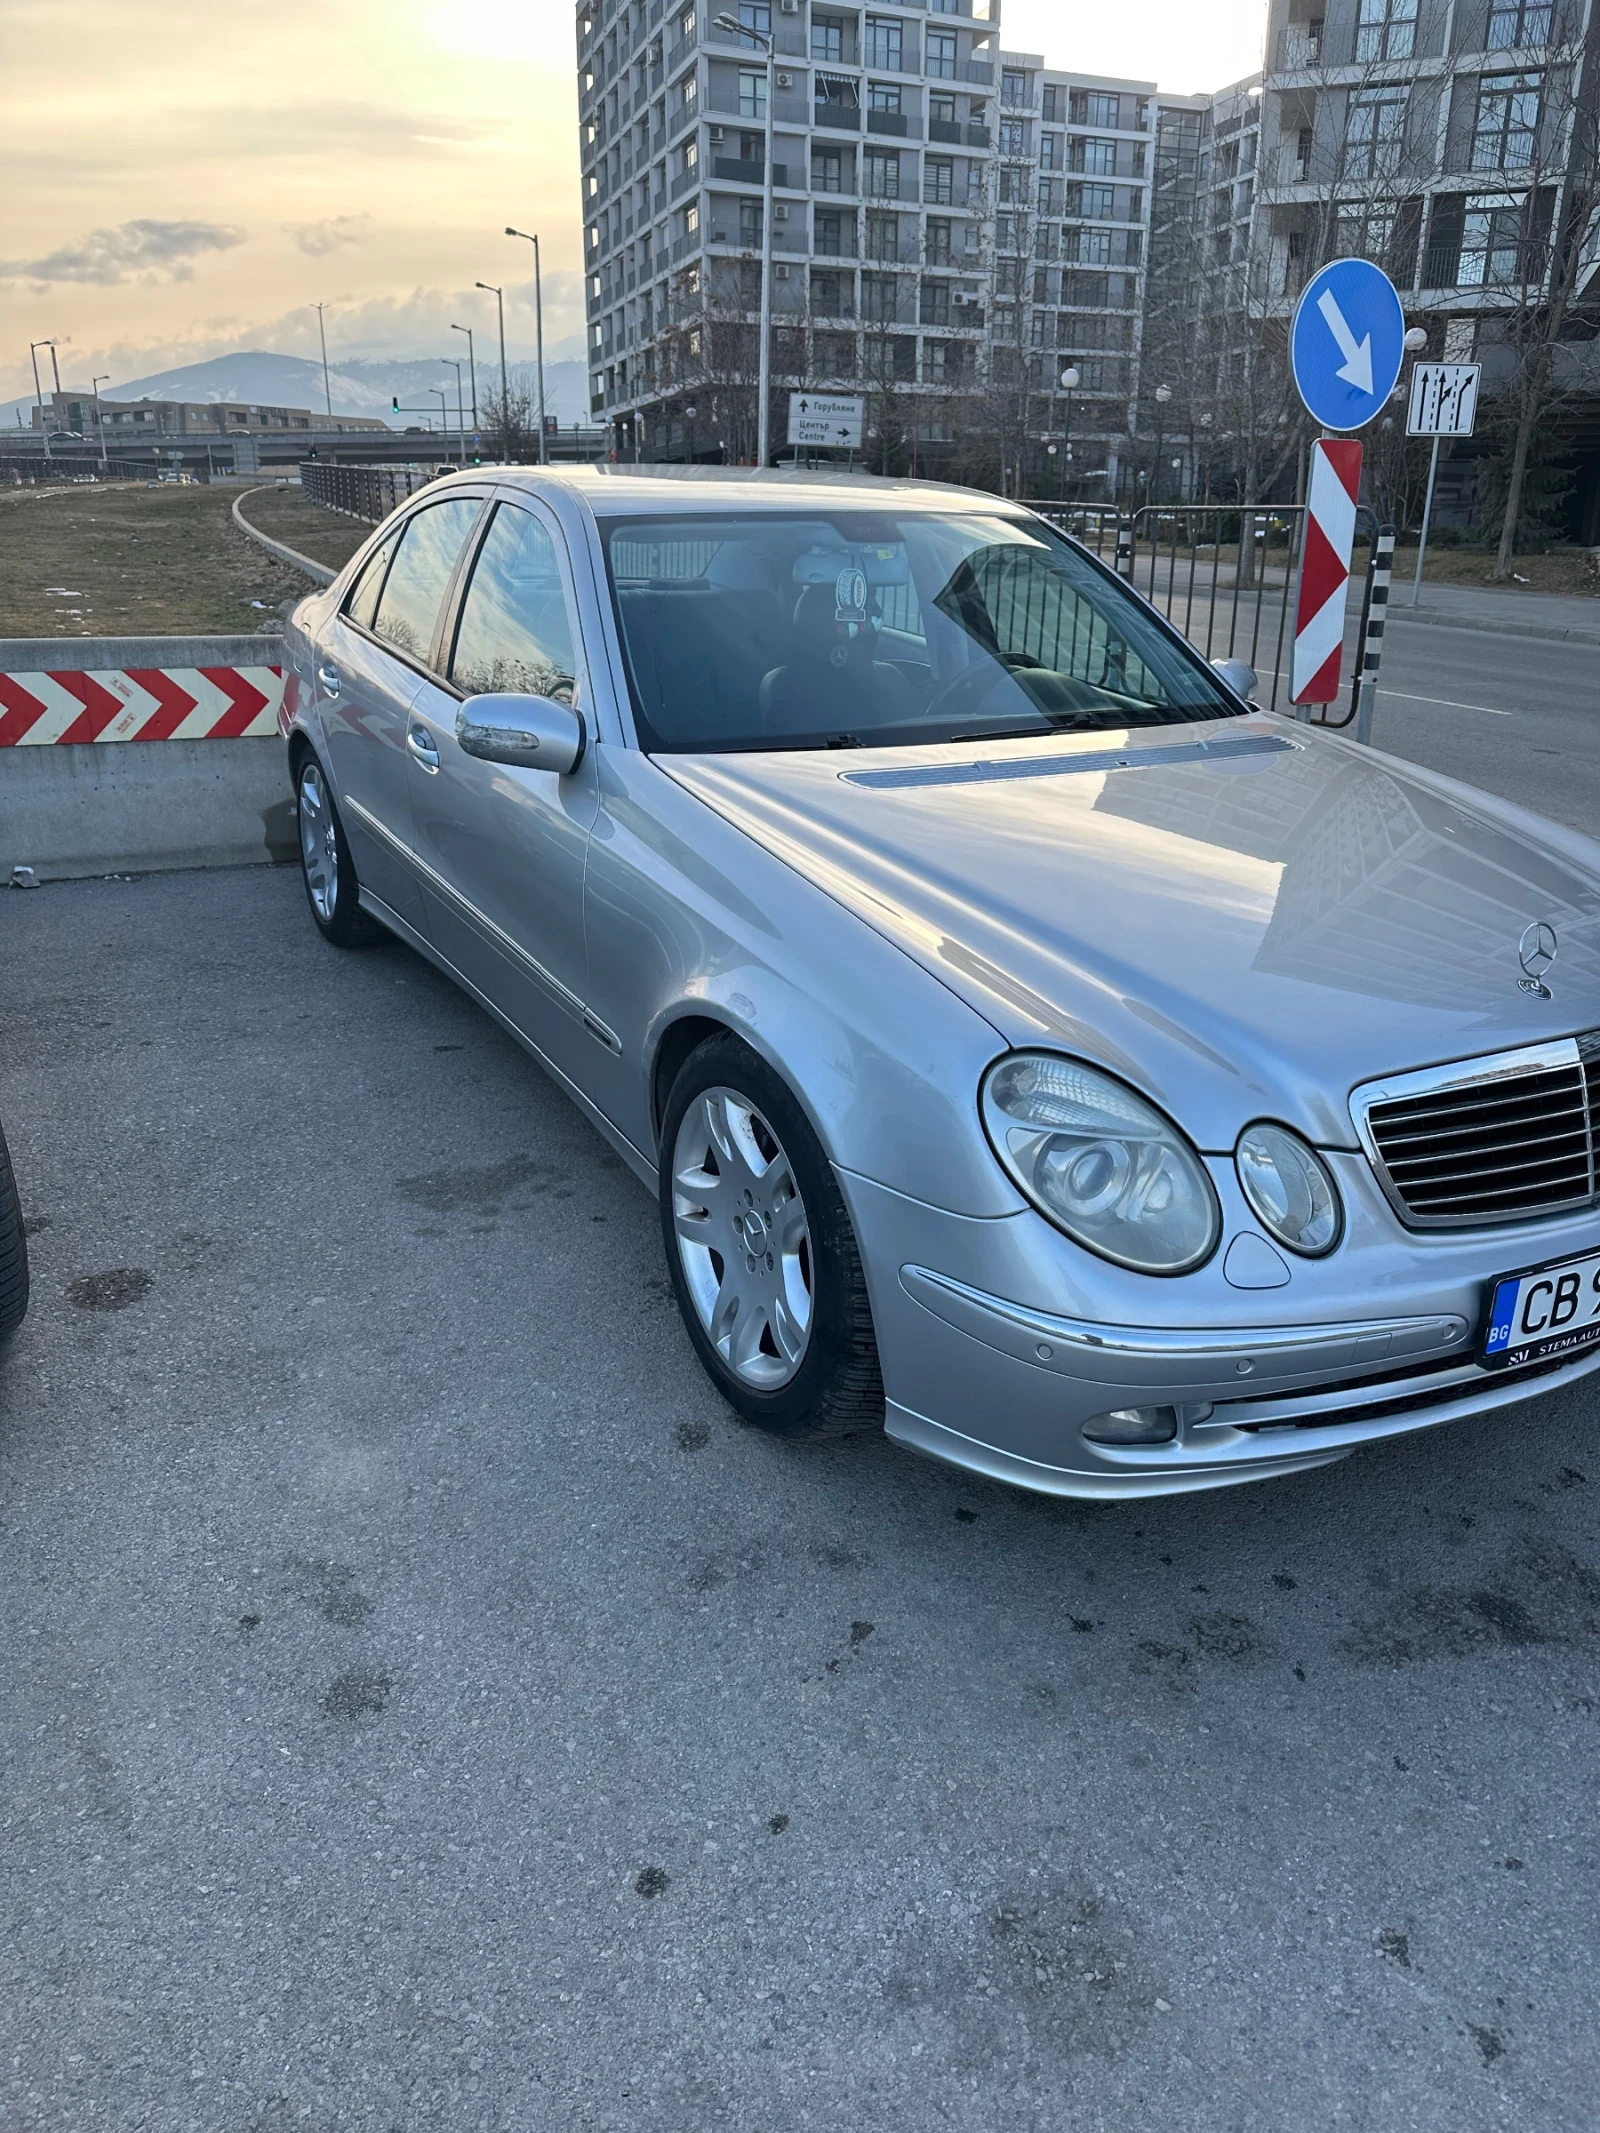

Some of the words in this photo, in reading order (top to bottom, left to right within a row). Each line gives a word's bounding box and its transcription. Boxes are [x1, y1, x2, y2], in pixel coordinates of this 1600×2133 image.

[814, 402, 855, 413] Горубляне
[799, 420, 829, 431] Център
[799, 432, 825, 441] Centre
[1489, 1325, 1509, 1344] BG
